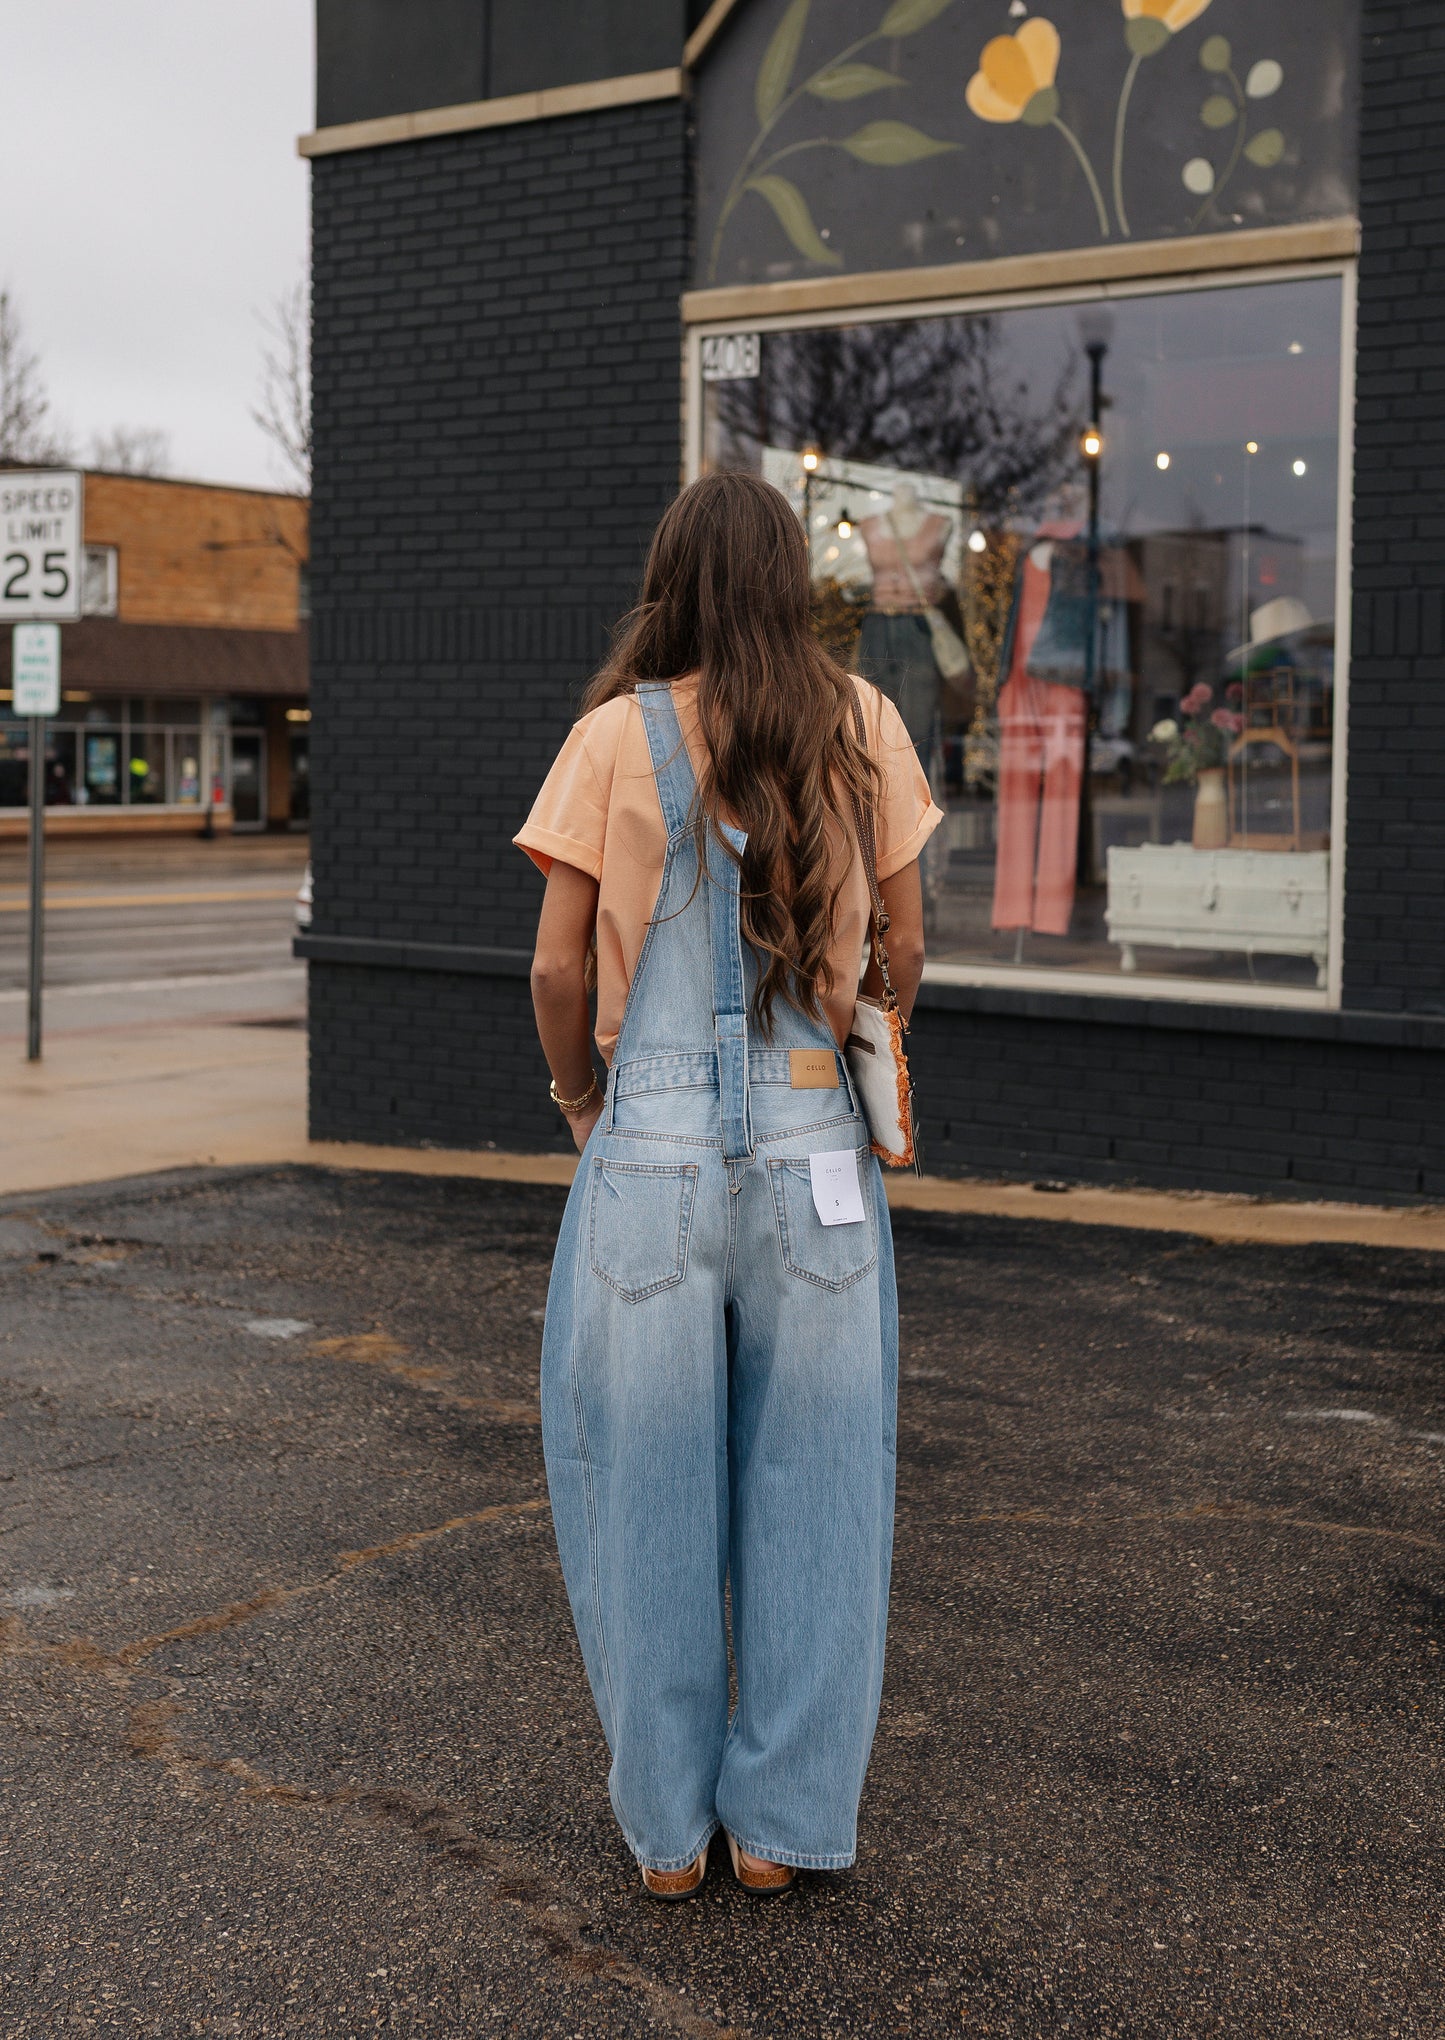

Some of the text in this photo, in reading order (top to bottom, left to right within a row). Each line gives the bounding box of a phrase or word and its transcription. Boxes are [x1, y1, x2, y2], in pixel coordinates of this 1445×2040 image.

[2, 488, 73, 513] SPEED
[7, 518, 62, 541] LIMIT
[4, 551, 69, 598] 25
[835, 1199, 840, 1207] S
